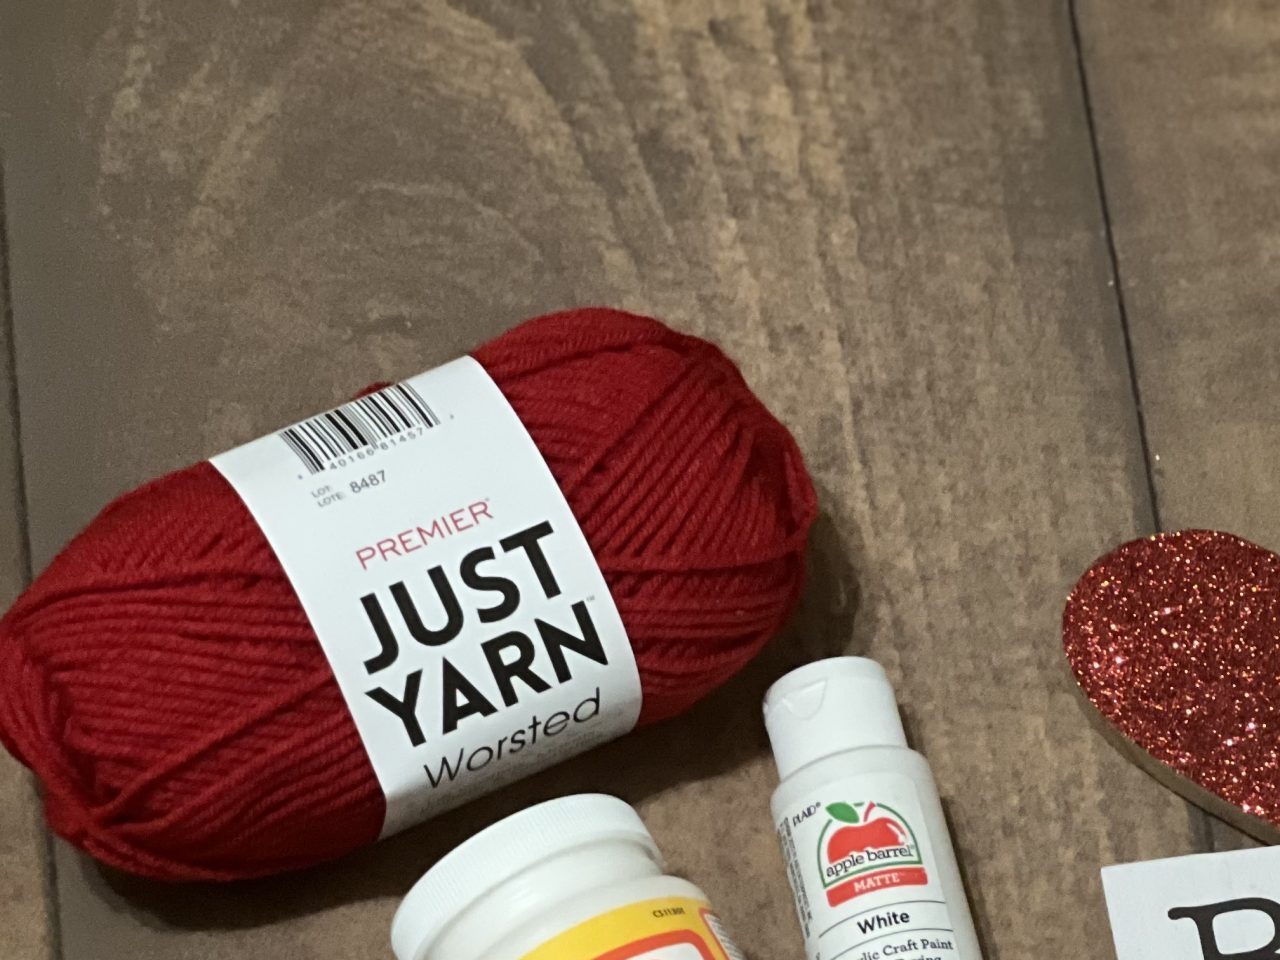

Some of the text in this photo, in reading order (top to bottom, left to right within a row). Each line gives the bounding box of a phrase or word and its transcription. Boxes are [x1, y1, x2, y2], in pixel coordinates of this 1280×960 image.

[349, 470, 387, 494] 8487
[356, 501, 494, 571] PREMIER
[360, 520, 562, 675] JUST
[364, 600, 609, 748] YARN
[423, 686, 601, 789] Worsted
[792, 804, 817, 828] PLAID
[826, 844, 914, 878] apple barrel
[853, 872, 900, 894] MATTE
[857, 911, 911, 935] White
[882, 938, 918, 957] Craft
[920, 937, 954, 951] Paint
